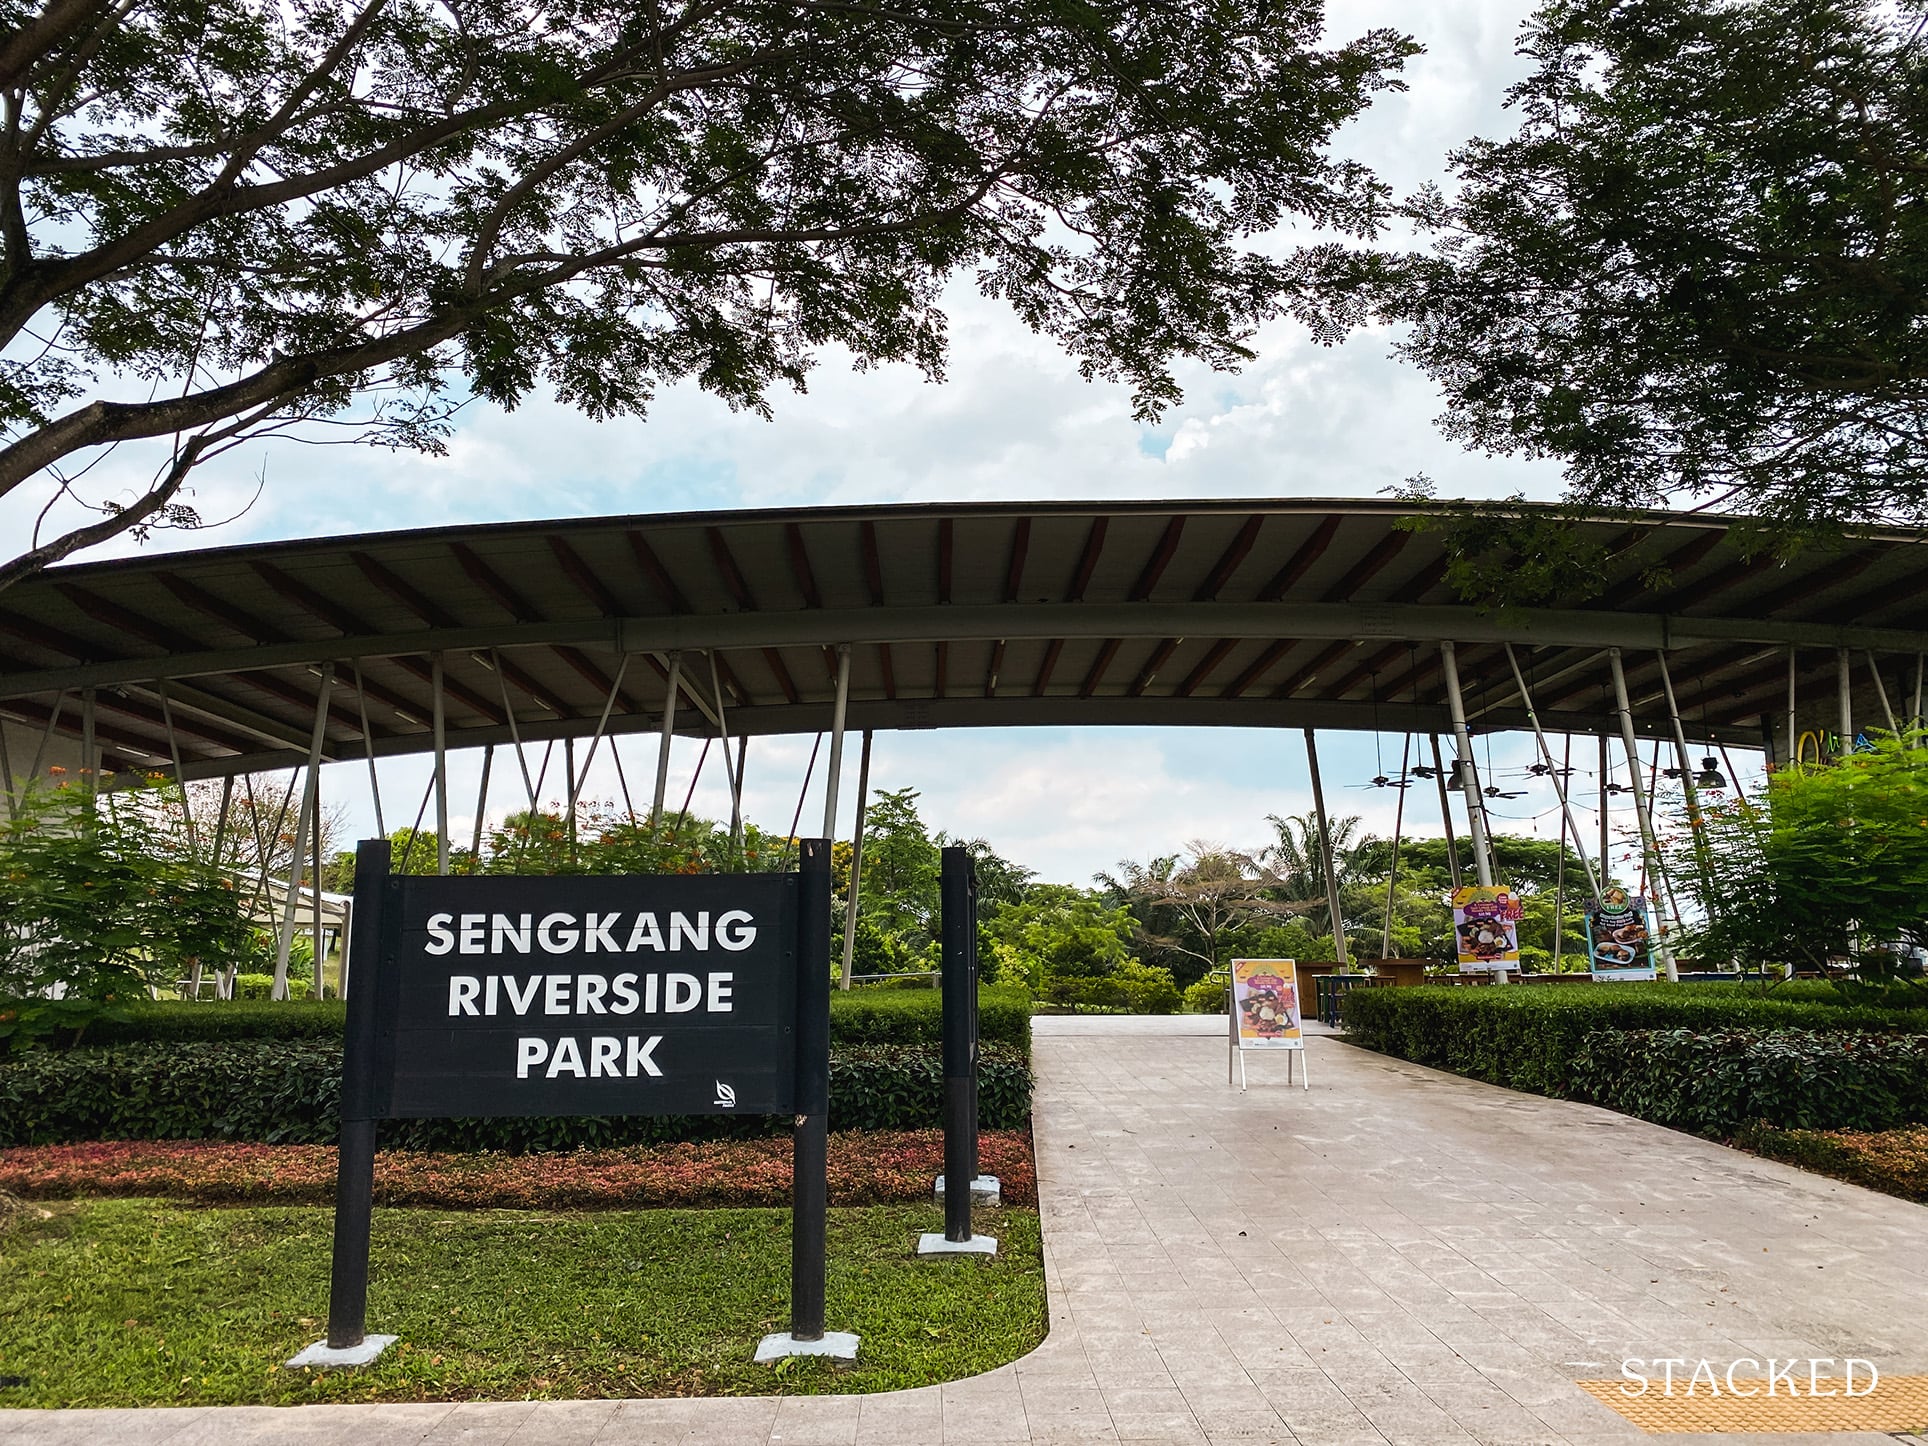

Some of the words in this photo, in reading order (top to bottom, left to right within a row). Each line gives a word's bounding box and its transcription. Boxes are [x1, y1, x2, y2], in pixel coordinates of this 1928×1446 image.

[424, 909, 757, 956] SENGKANG
[1500, 907, 1524, 920] FREE
[448, 971, 734, 1017] RIVERSIDE
[516, 1035, 664, 1079] PARK
